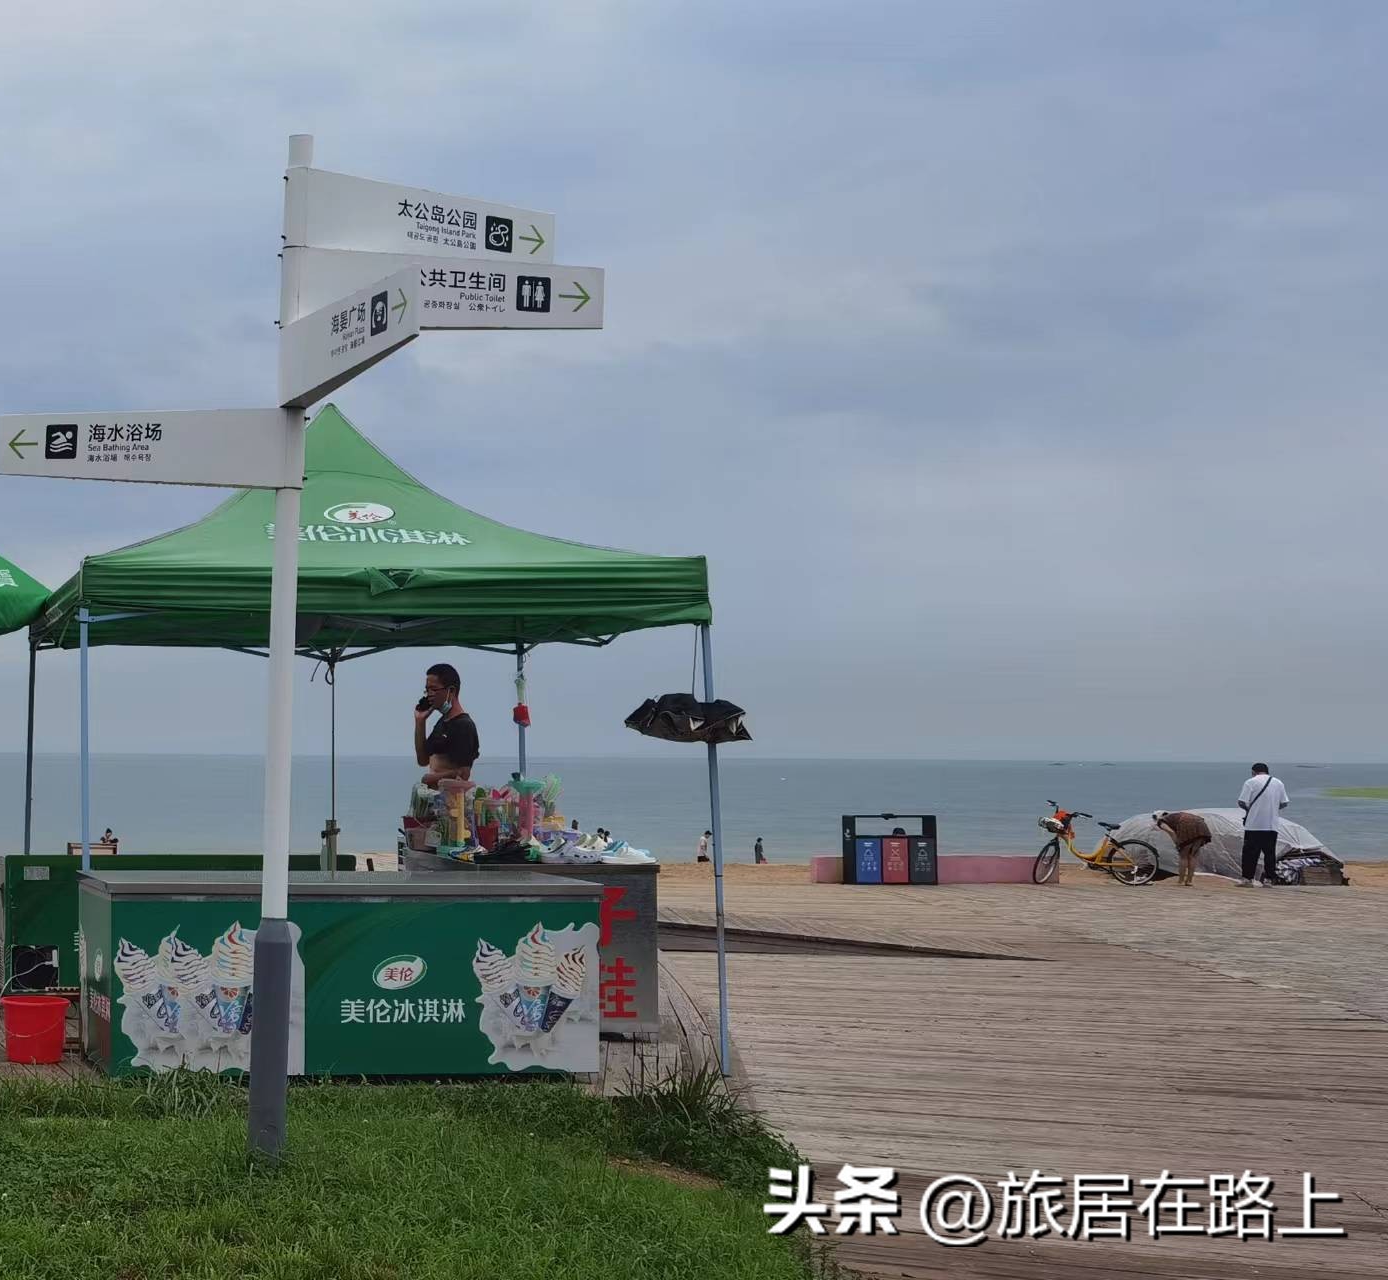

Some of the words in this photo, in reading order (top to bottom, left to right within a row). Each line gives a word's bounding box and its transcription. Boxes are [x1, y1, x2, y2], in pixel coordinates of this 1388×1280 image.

[398, 199, 477, 230] 太公岛公园
[416, 222, 440, 234] Taigong
[441, 226, 461, 237] Island
[462, 230, 476, 239] Park
[460, 292, 483, 301] Public
[485, 294, 505, 303] Toilet
[88, 423, 162, 442] 海水浴场
[103, 444, 131, 452] Bathing
[132, 443, 149, 451] Area
[384, 967, 414, 982] 美伦
[340, 998, 466, 1024] 美伦冰淇淋
